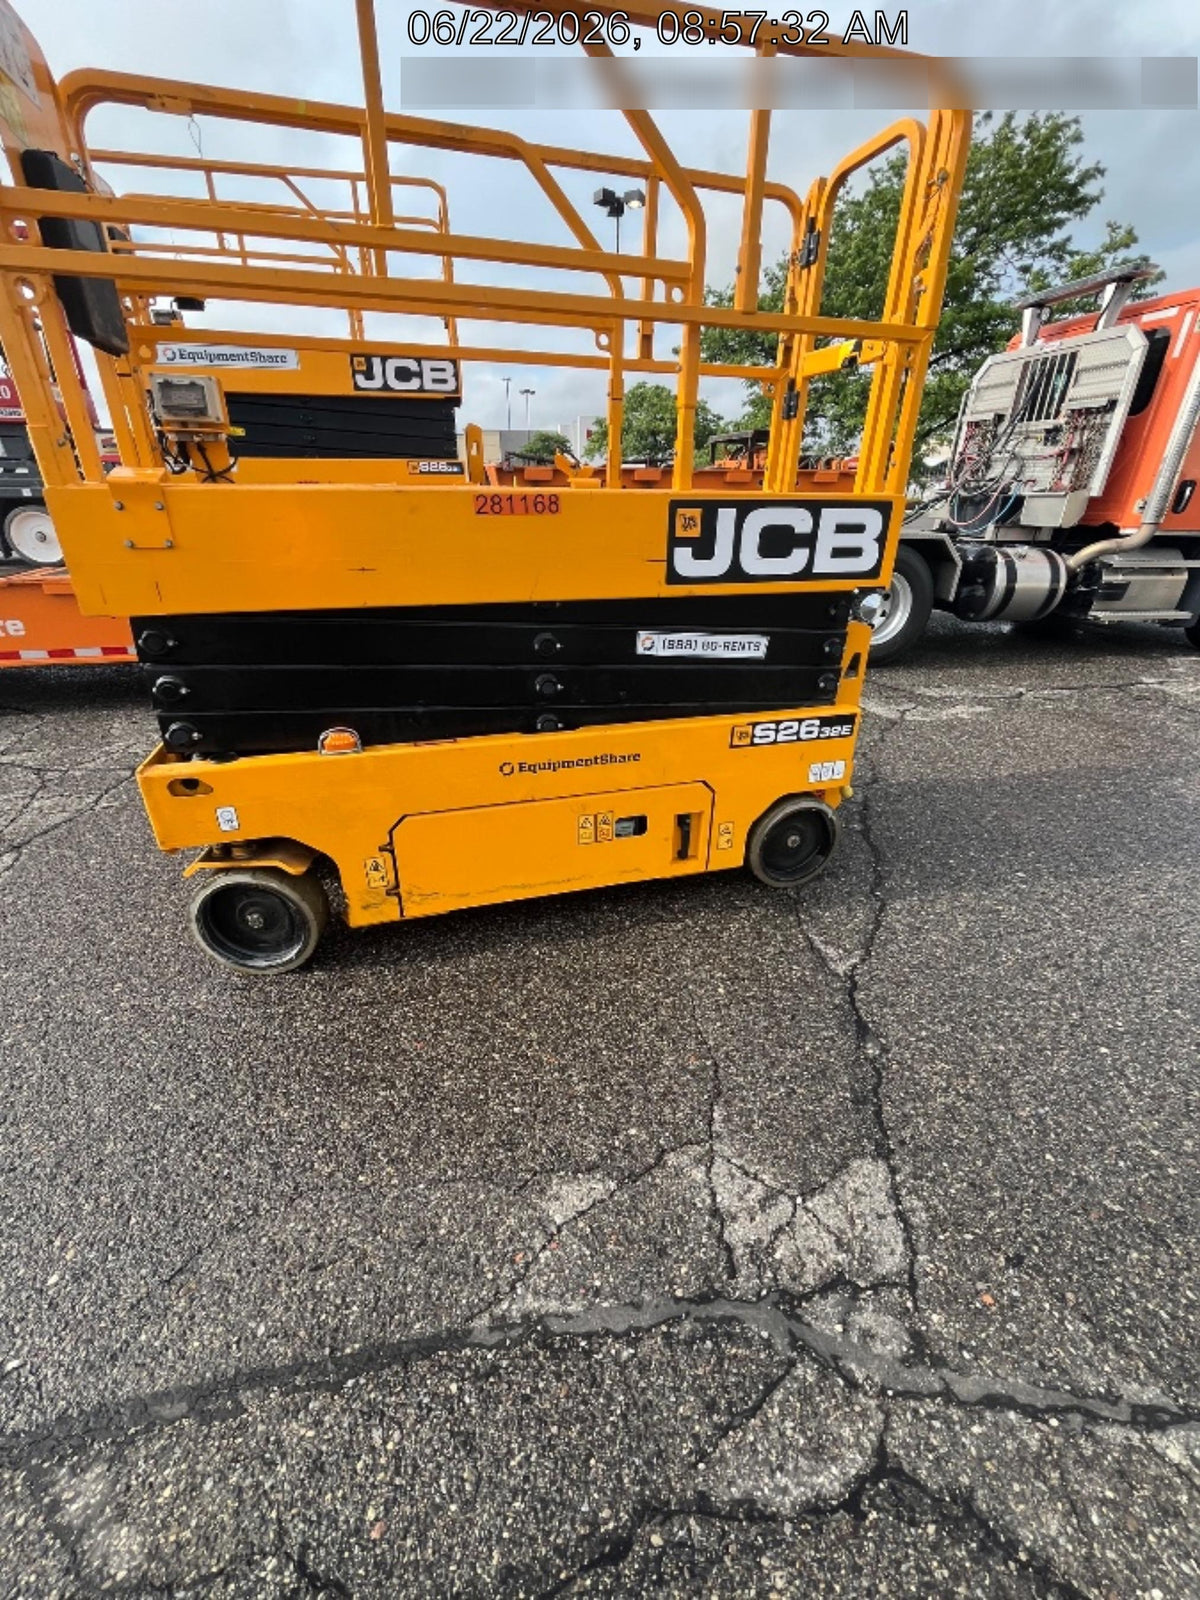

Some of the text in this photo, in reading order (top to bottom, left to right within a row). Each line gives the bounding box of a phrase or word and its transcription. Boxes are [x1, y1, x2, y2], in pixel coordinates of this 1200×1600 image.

[178, 349, 288, 364] EquipmentShare
[355, 357, 457, 391] JCB
[475, 493, 560, 515] 281168
[673, 507, 883, 577] JCB
[518, 753, 641, 773] EquipmentShare
